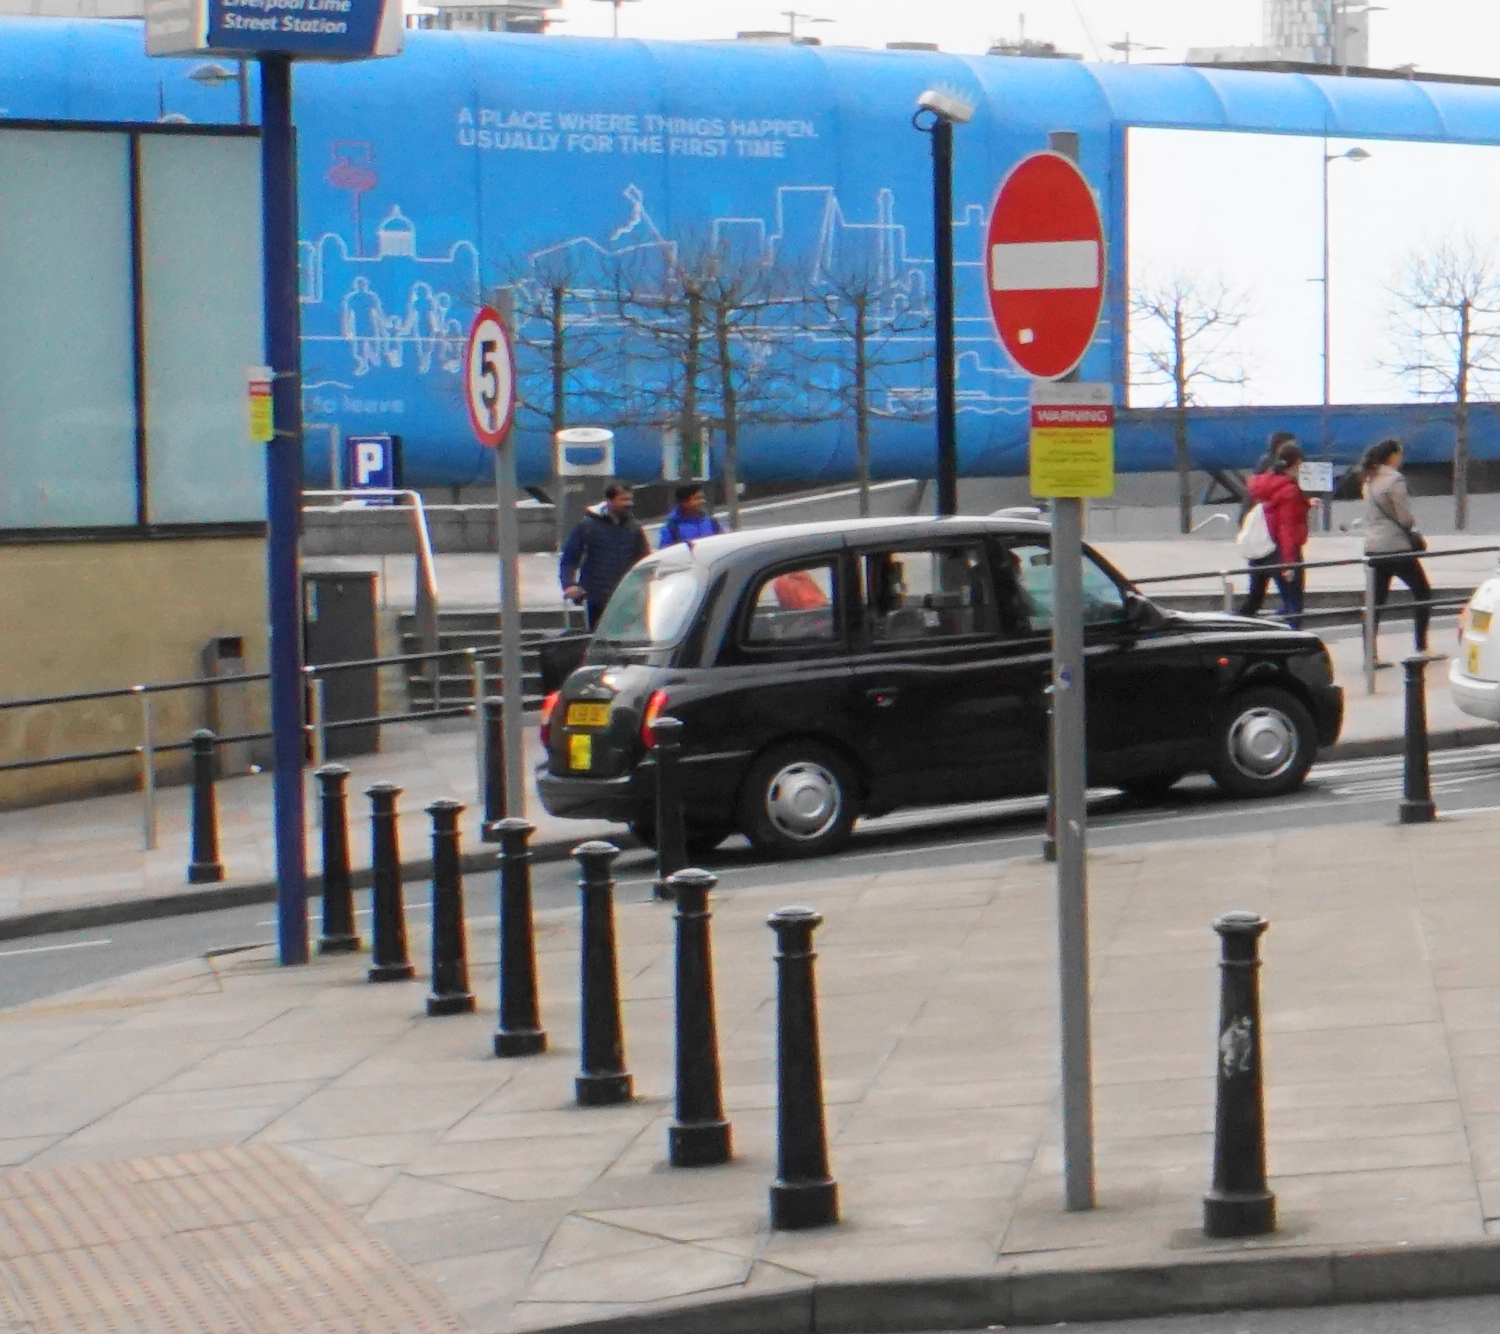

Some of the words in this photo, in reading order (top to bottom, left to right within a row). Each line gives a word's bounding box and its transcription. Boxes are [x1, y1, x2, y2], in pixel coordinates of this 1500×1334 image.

[222, 13, 278, 31] Street
[281, 15, 348, 34] Station
[457, 107, 474, 125] A
[479, 108, 552, 130] PLACE
[557, 112, 637, 134] WHERE
[644, 114, 726, 137] THINGS
[458, 128, 559, 151] USUALLY
[566, 133, 614, 154] FOR
[620, 134, 664, 154] THE
[669, 137, 727, 158] FIRST
[734, 138, 786, 158] TIME
[481, 340, 499, 409] 5
[1035, 409, 1108, 423] WARNING
[356, 442, 384, 485] P
